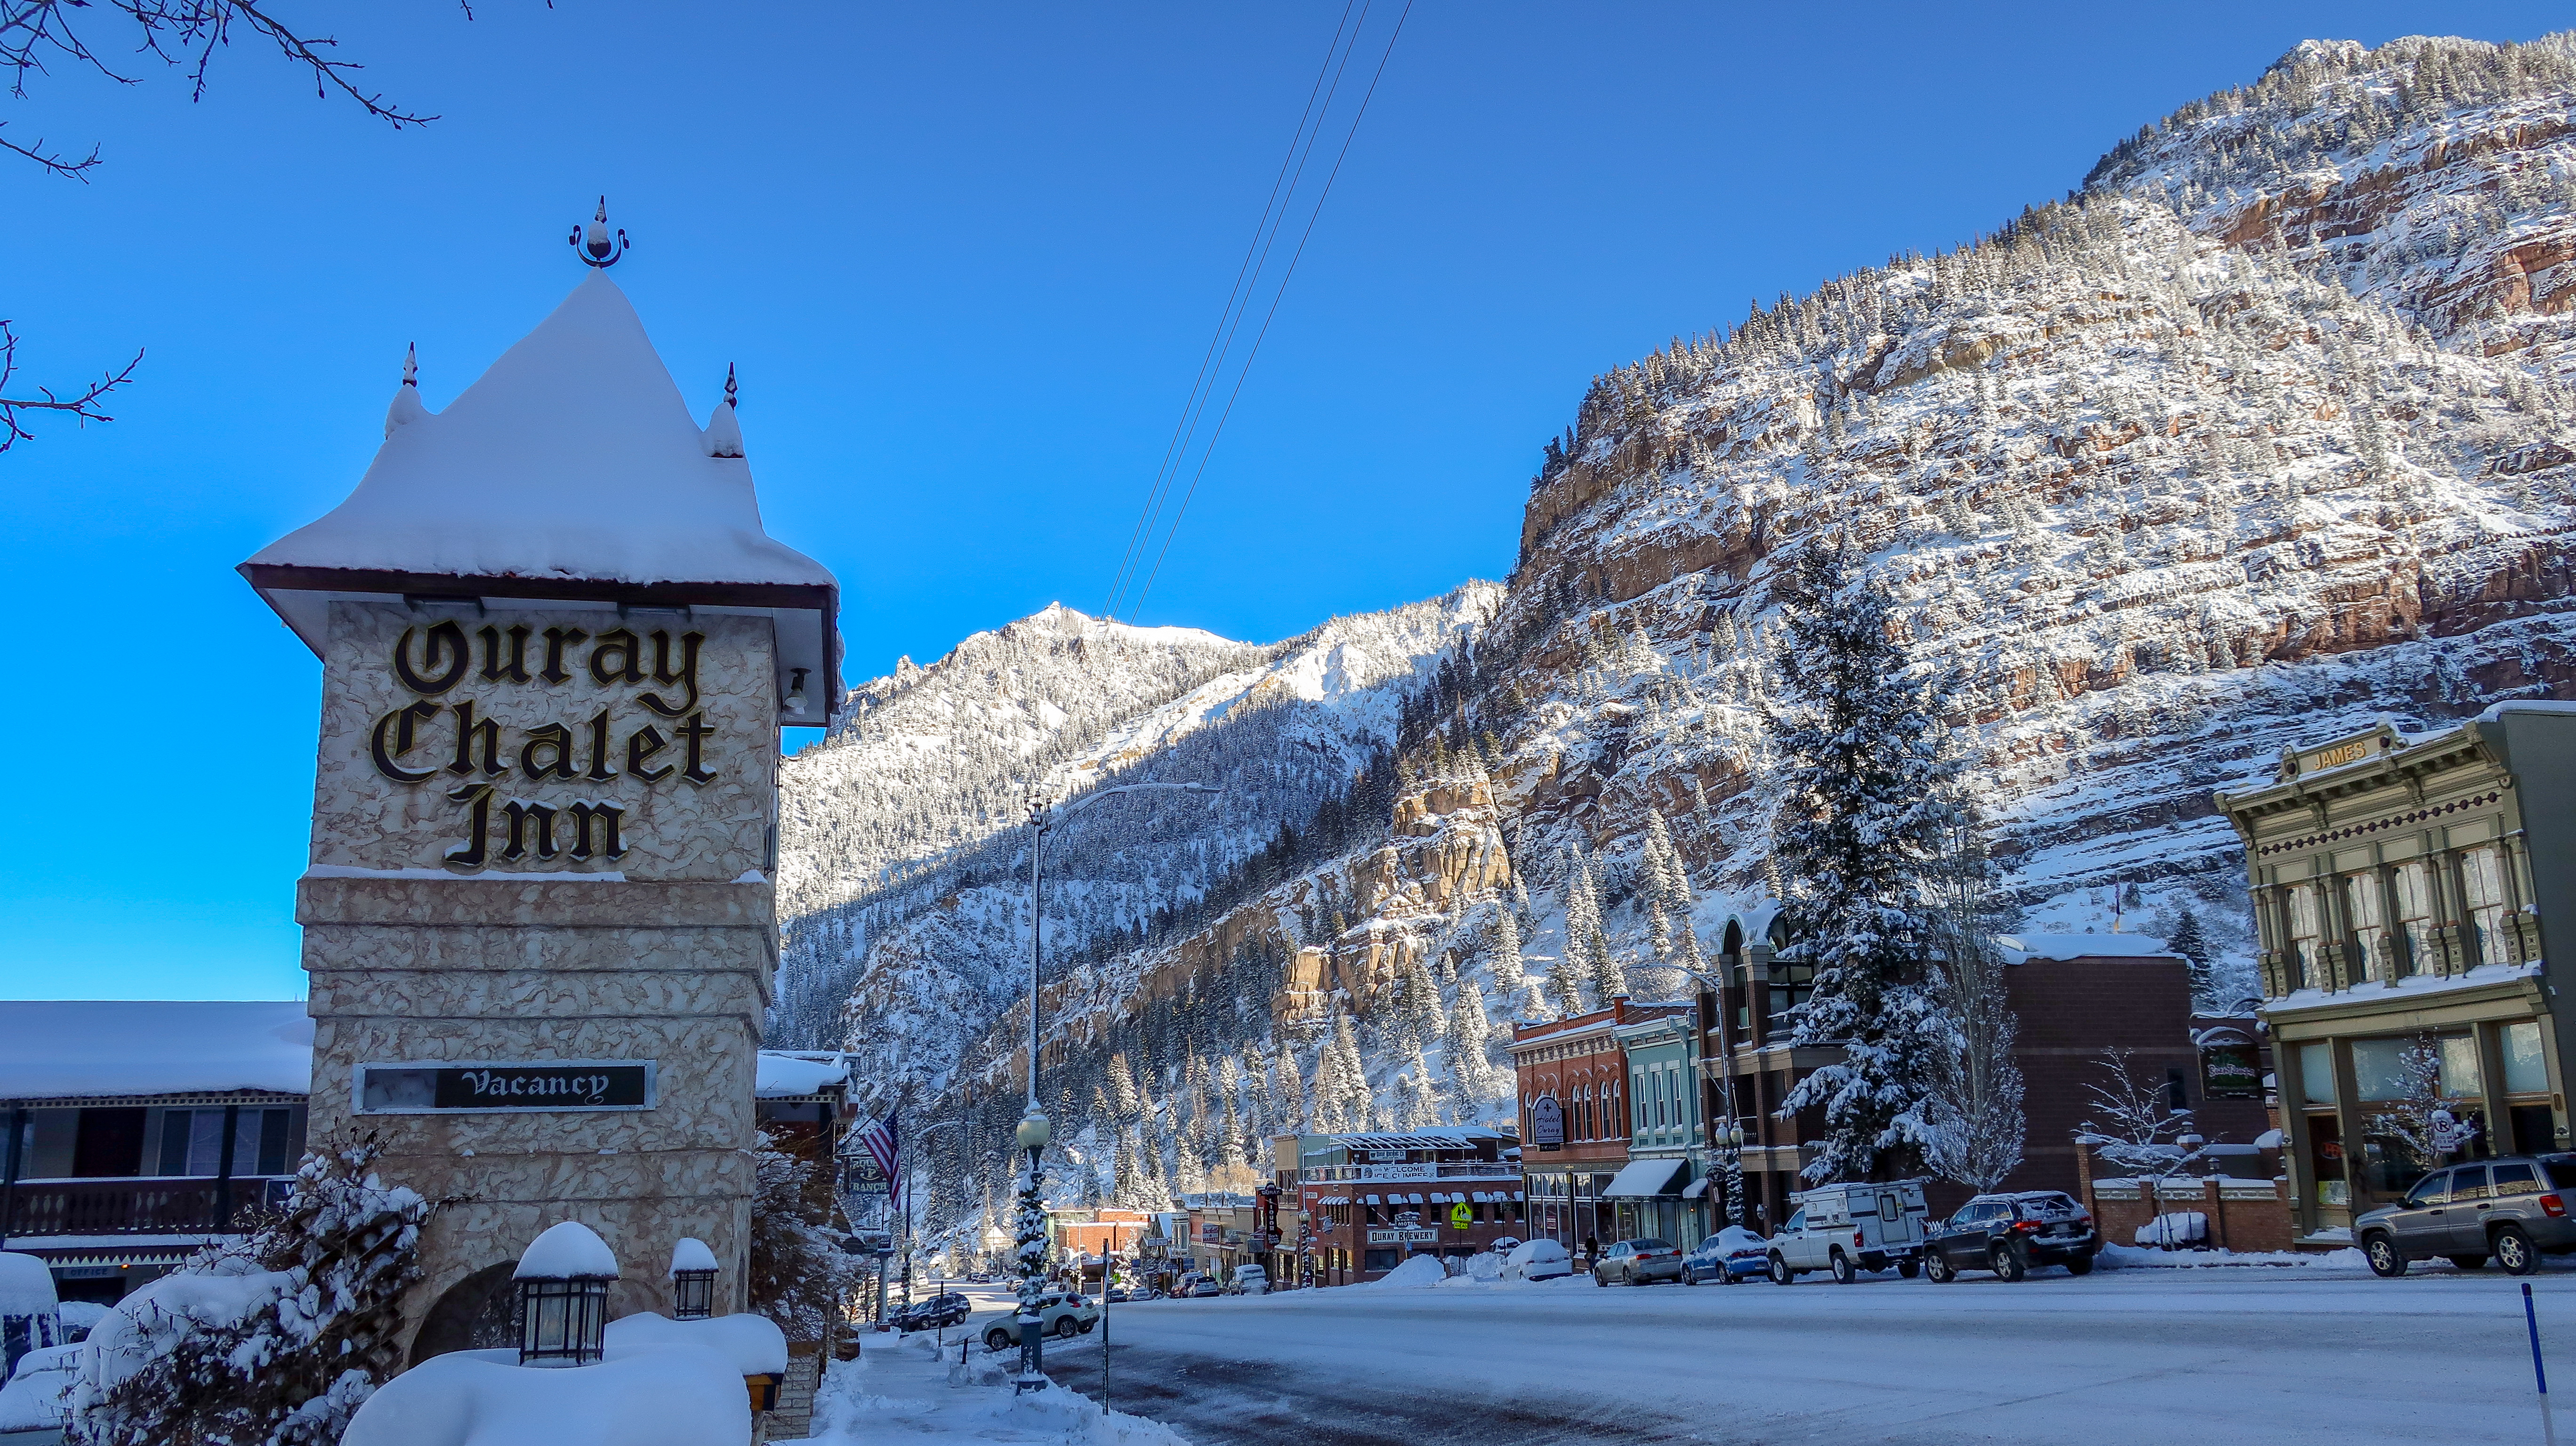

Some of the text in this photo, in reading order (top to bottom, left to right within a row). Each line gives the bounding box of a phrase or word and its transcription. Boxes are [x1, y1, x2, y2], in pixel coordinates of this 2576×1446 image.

[394, 619, 705, 718] Ouray
[370, 698, 718, 786] Chalet
[2314, 742, 2366, 769] JAMES
[443, 781, 628, 867] Inn
[461, 1069, 609, 1106] Vacancy
[1536, 1113, 1561, 1124] Hotel
[1537, 1125, 1561, 1136] Ouray
[853, 1182, 887, 1191] RANCH
[1372, 1232, 1433, 1241] OURAY BREWERY
